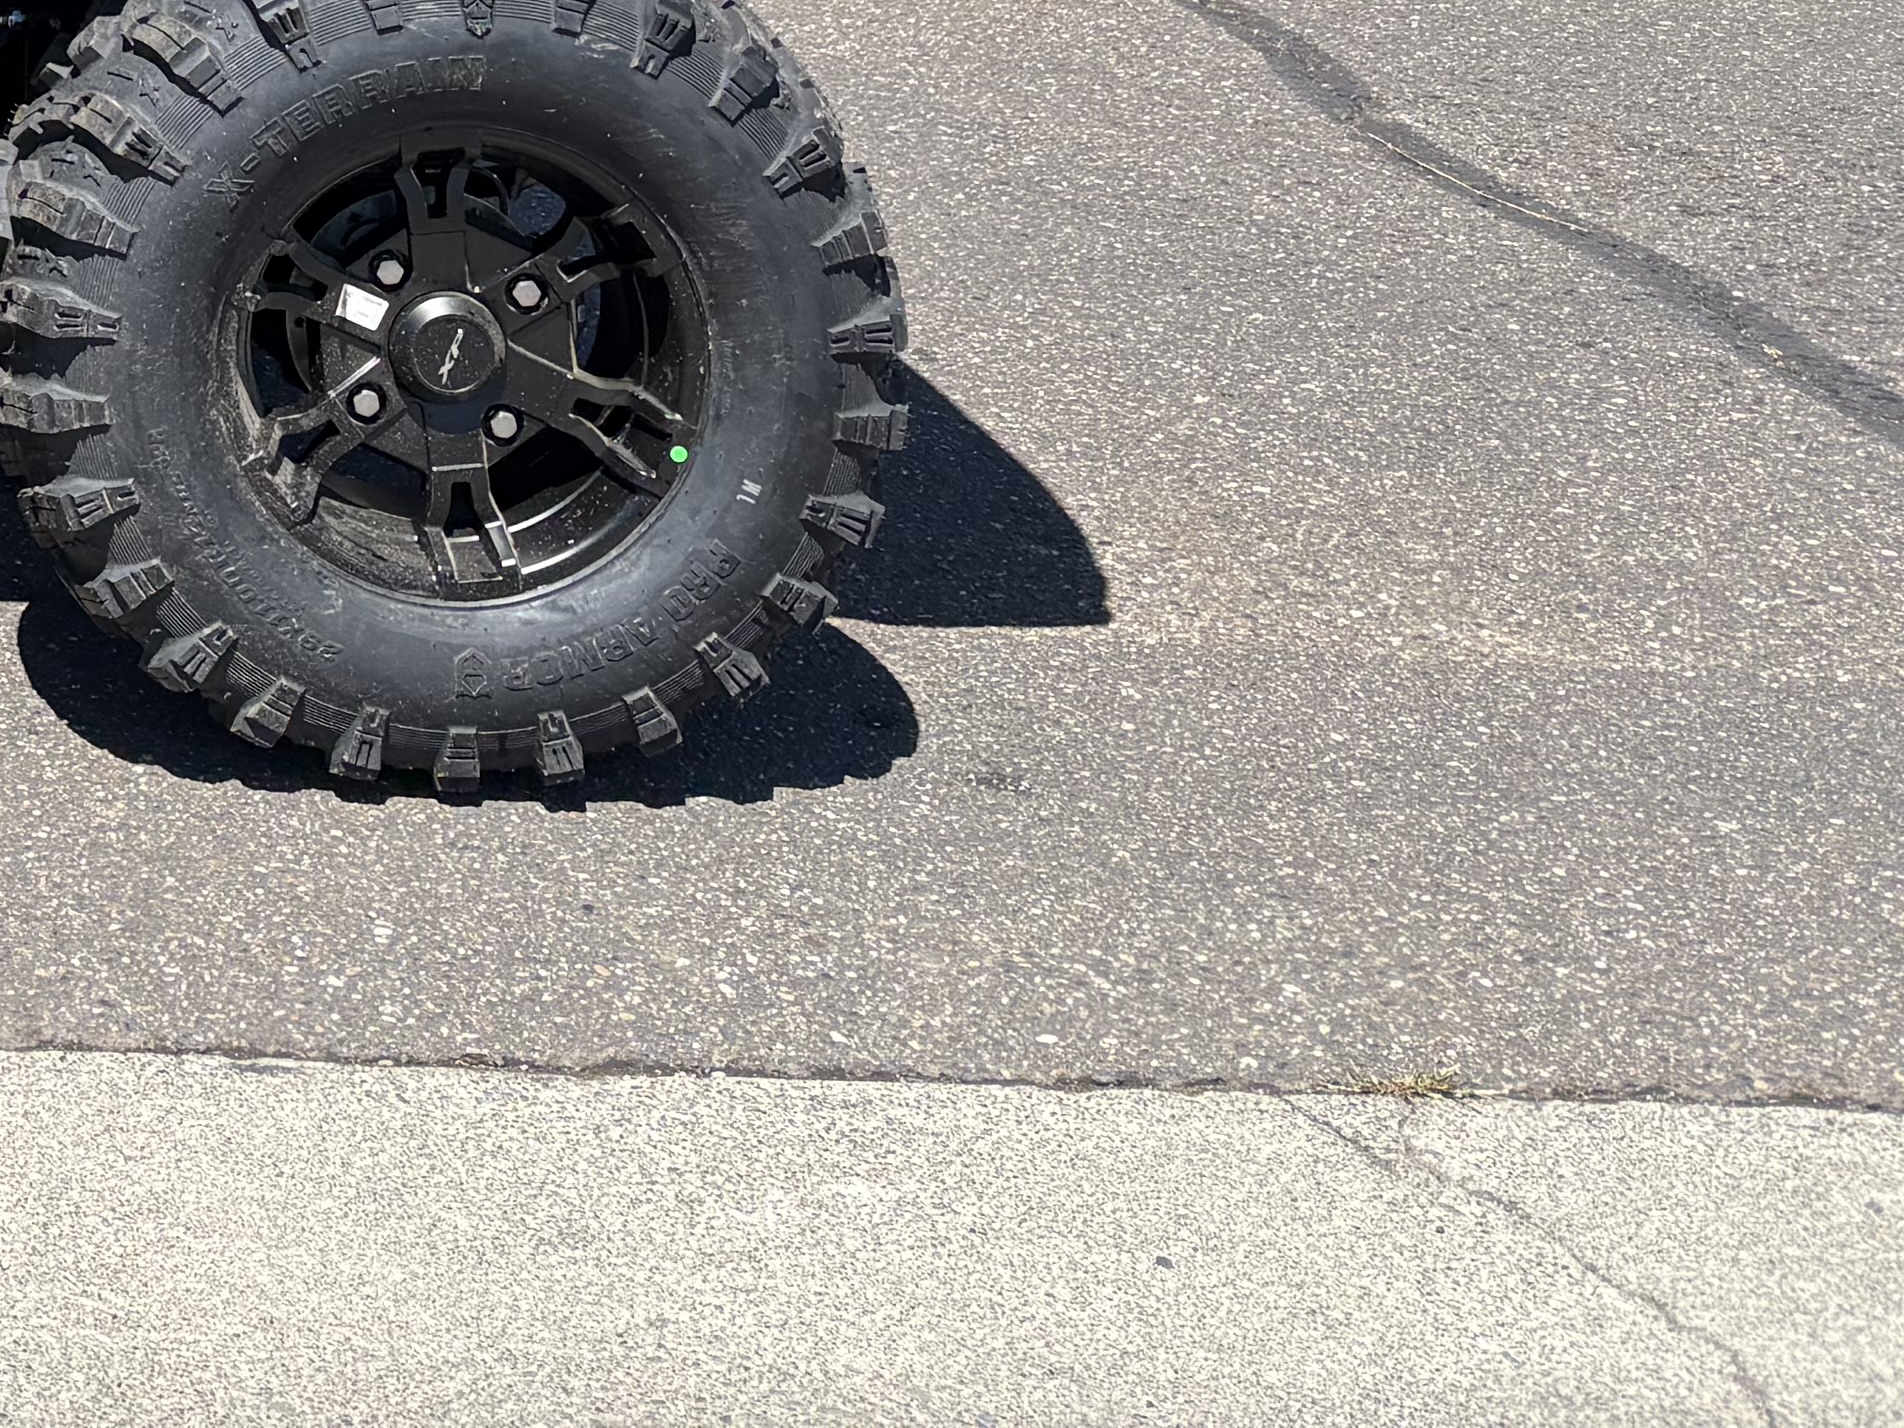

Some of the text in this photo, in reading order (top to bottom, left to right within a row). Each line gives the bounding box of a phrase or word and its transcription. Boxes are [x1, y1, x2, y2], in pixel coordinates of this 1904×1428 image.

[202, 55, 487, 214] X-TERRAIN
[500, 538, 744, 692] PRO ARMOR
